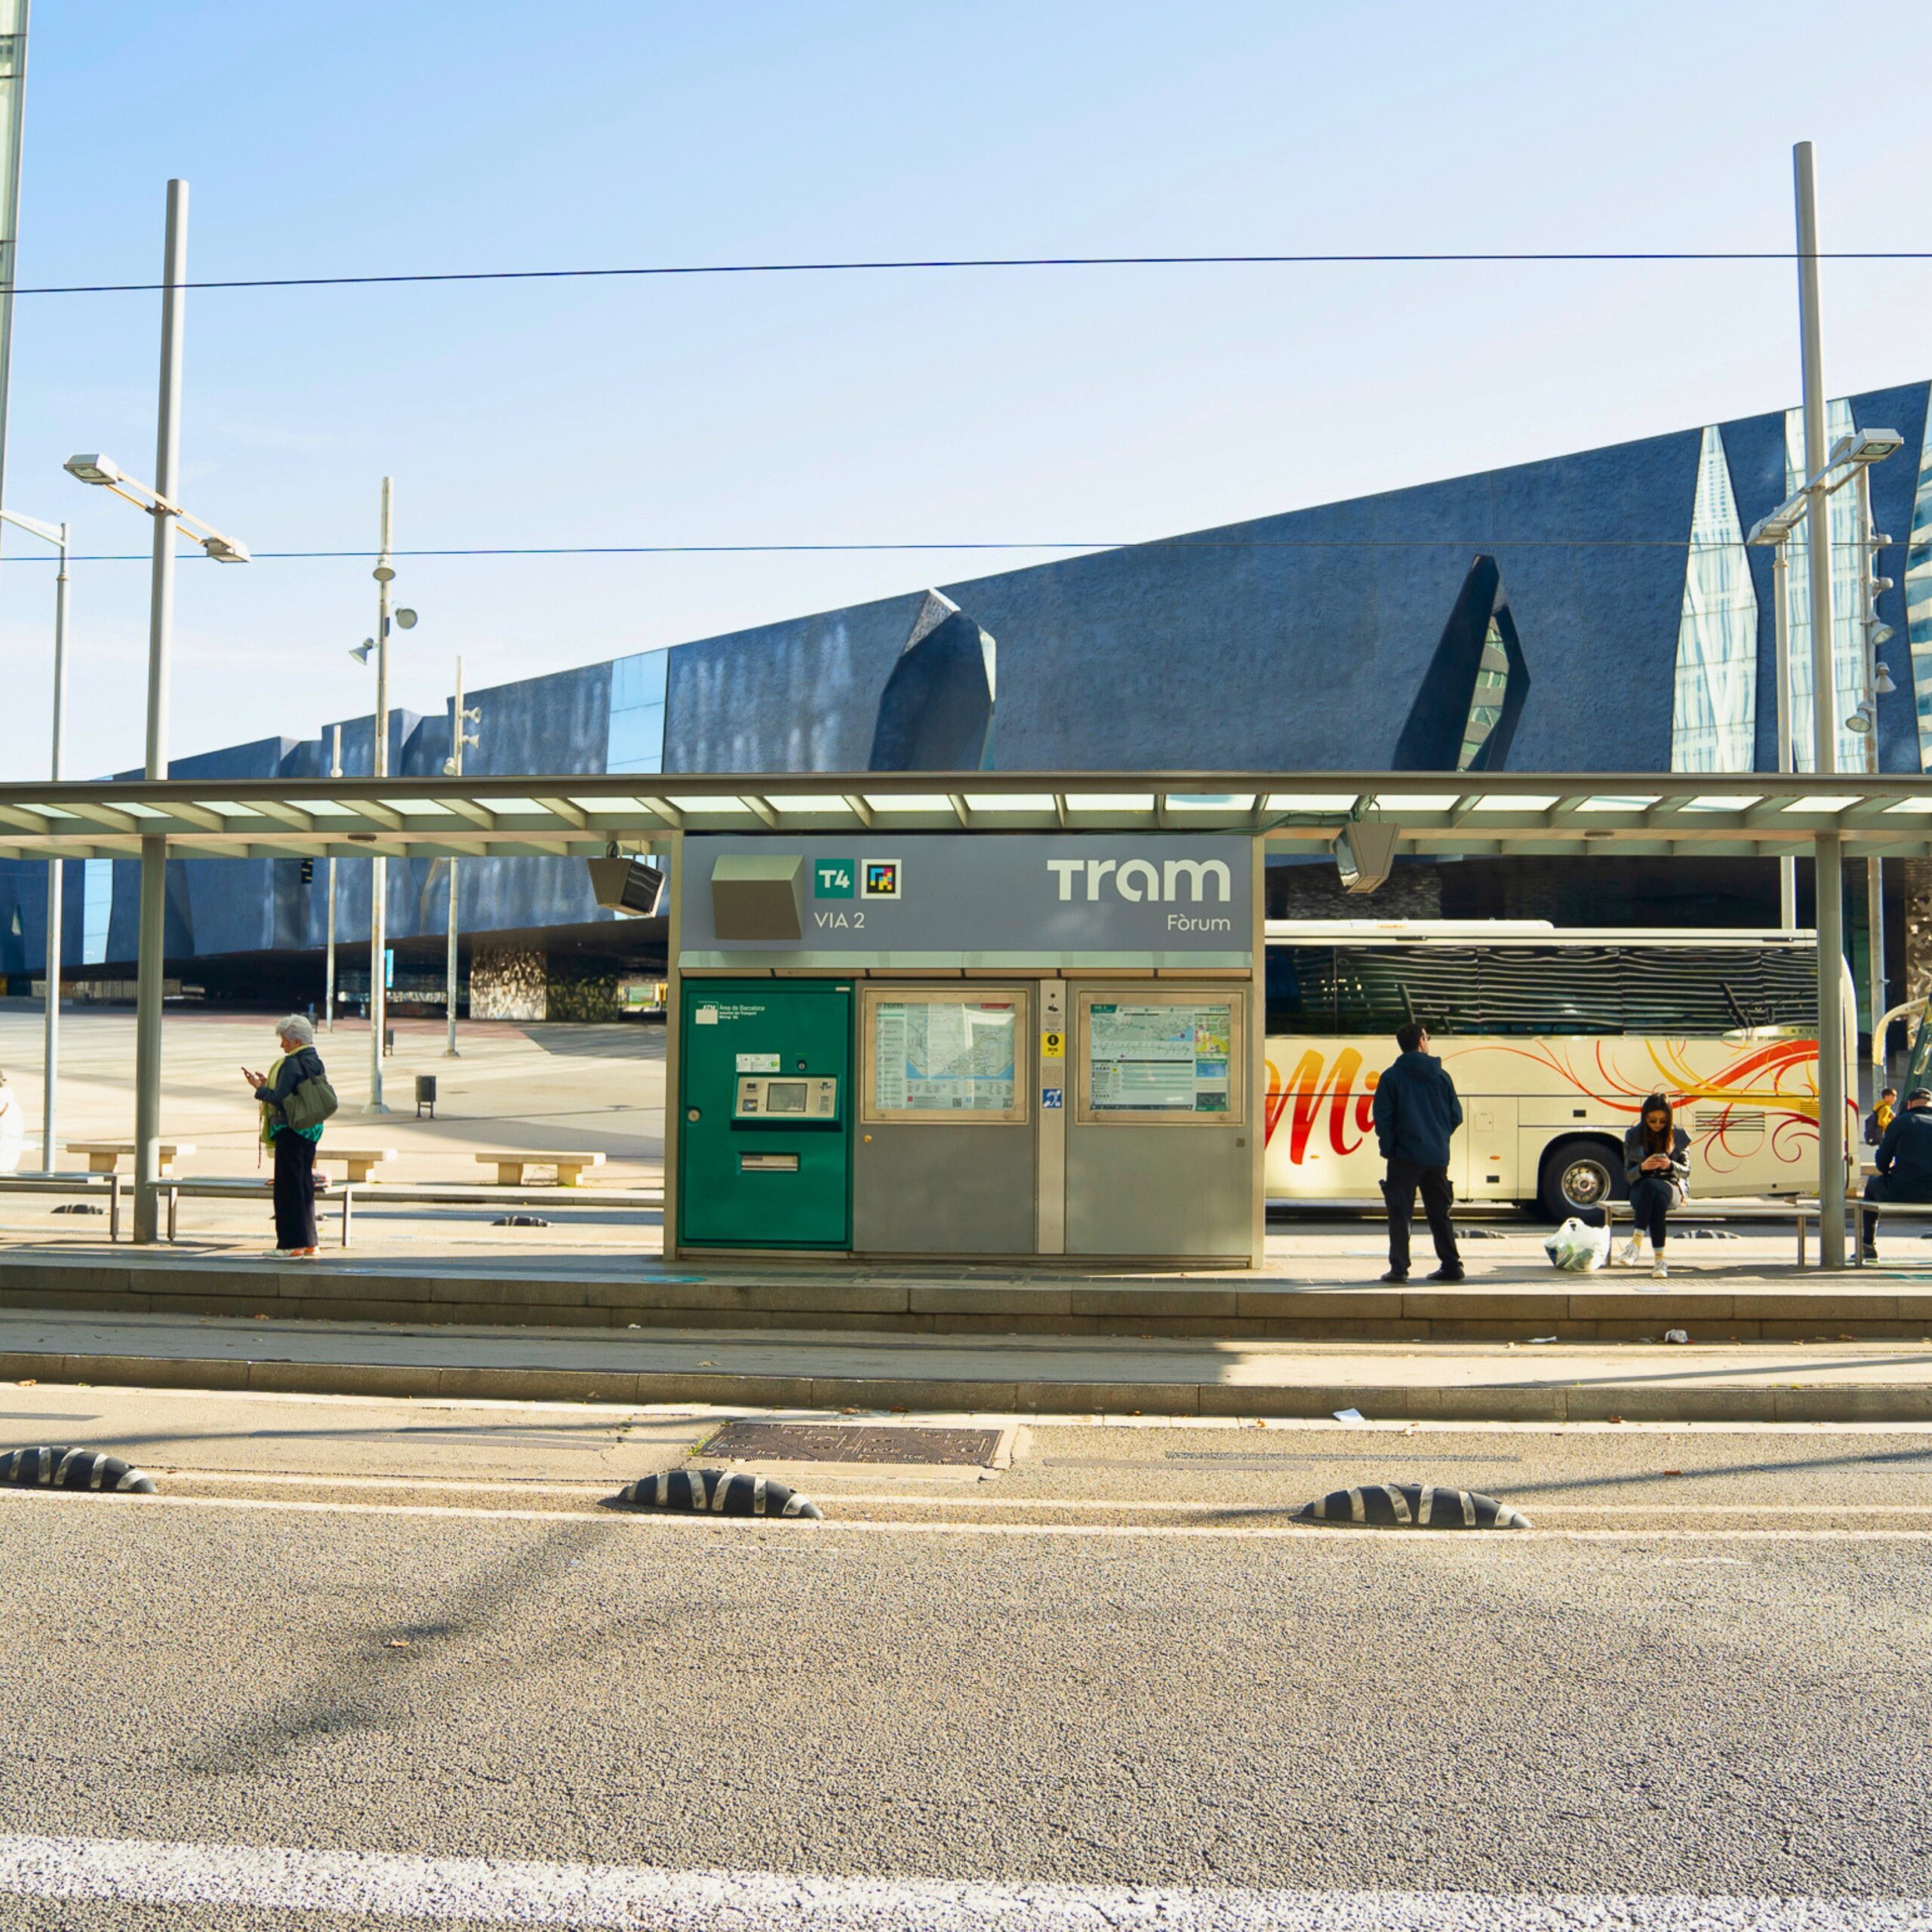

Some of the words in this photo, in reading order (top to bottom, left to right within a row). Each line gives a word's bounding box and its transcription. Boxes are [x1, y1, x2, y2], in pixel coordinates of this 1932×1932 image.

[819, 870, 850, 889] T4
[814, 913, 849, 928] VIA
[854, 913, 865, 928] 2
[1167, 914, 1231, 931] Fòrum
